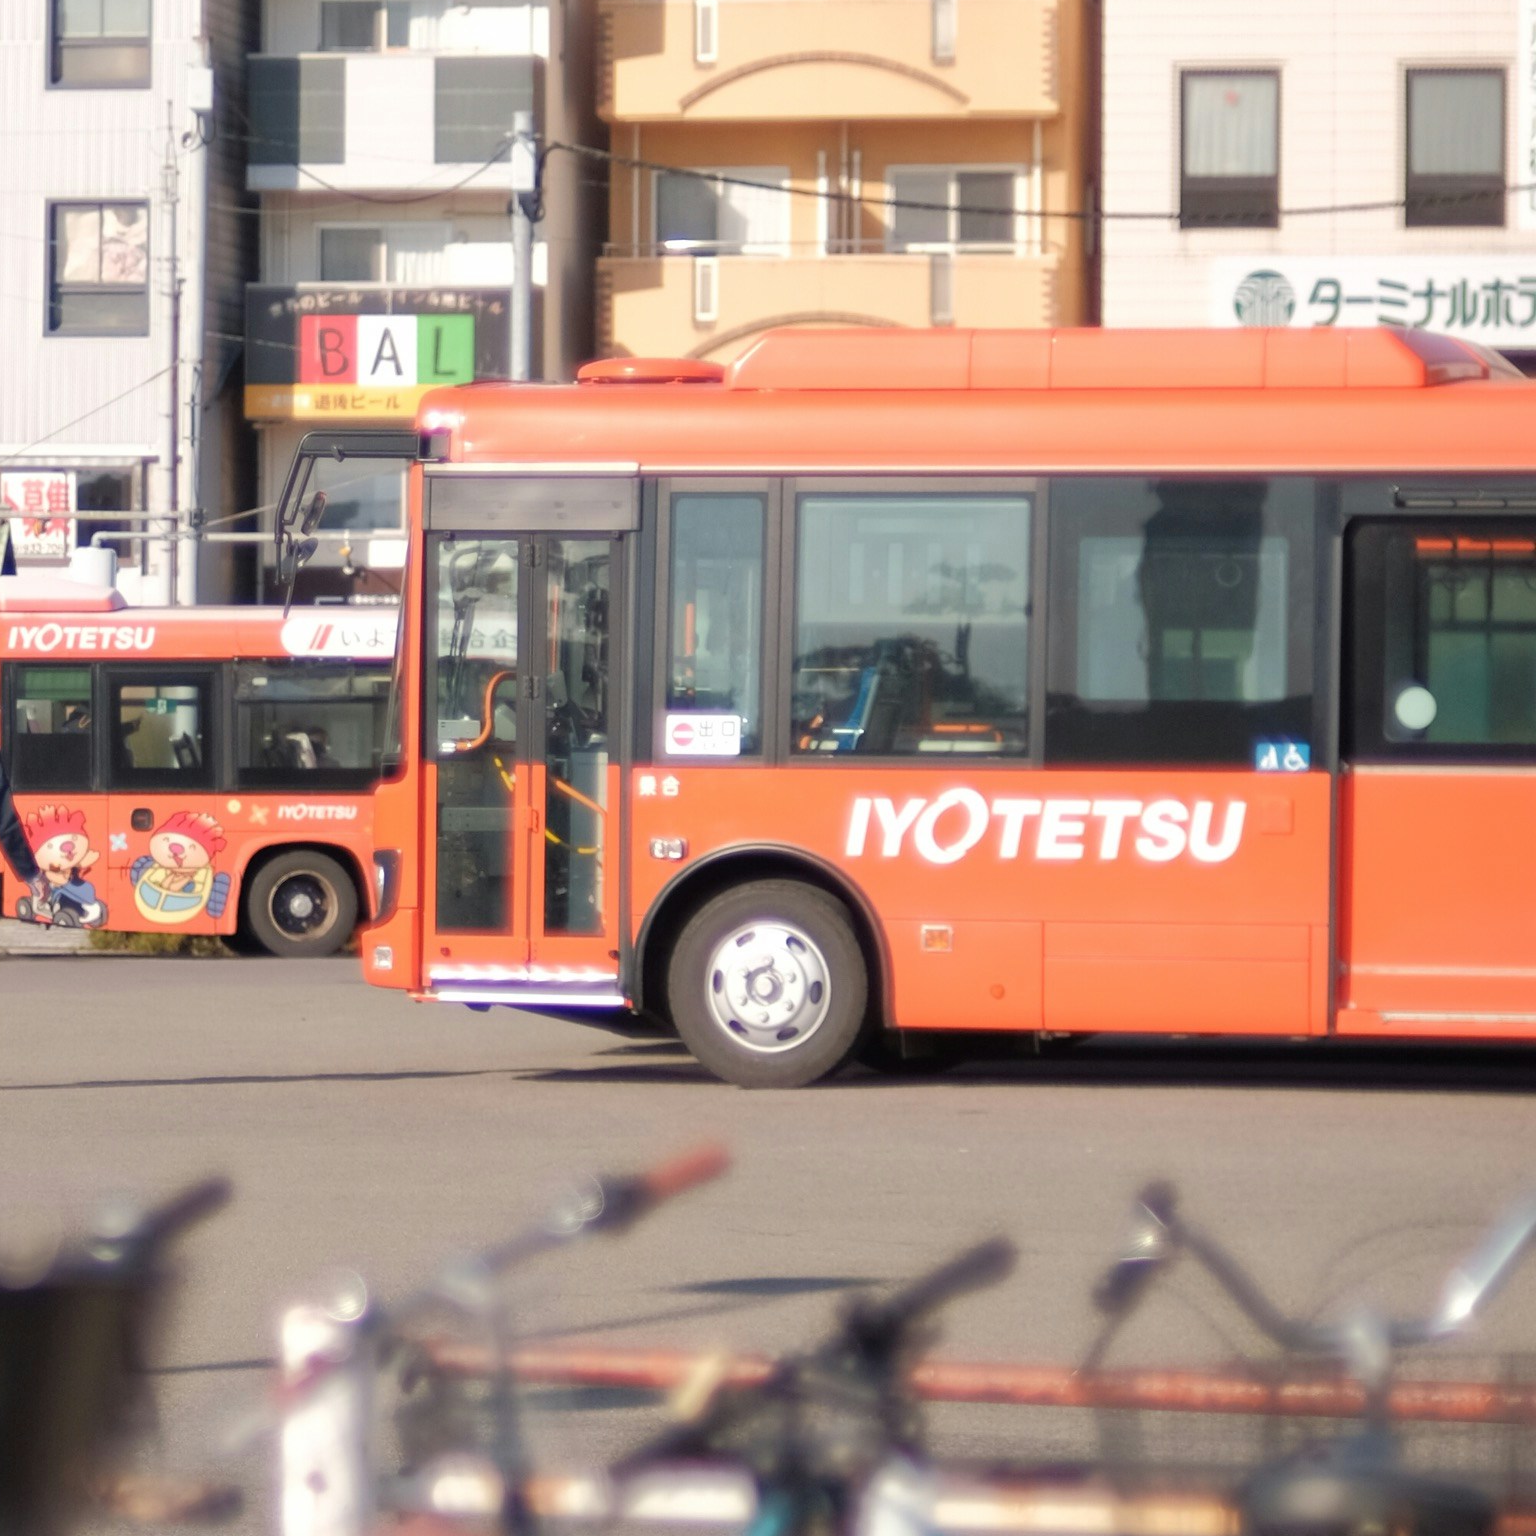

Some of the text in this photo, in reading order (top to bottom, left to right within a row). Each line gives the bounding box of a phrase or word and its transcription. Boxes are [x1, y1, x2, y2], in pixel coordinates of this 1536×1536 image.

[318, 326, 457, 377] BAL
[8, 622, 156, 652] IYOTETSU
[699, 720, 735, 737] 出口
[277, 802, 359, 821] IYOTETSU
[845, 787, 1247, 864] IYOTETSU
